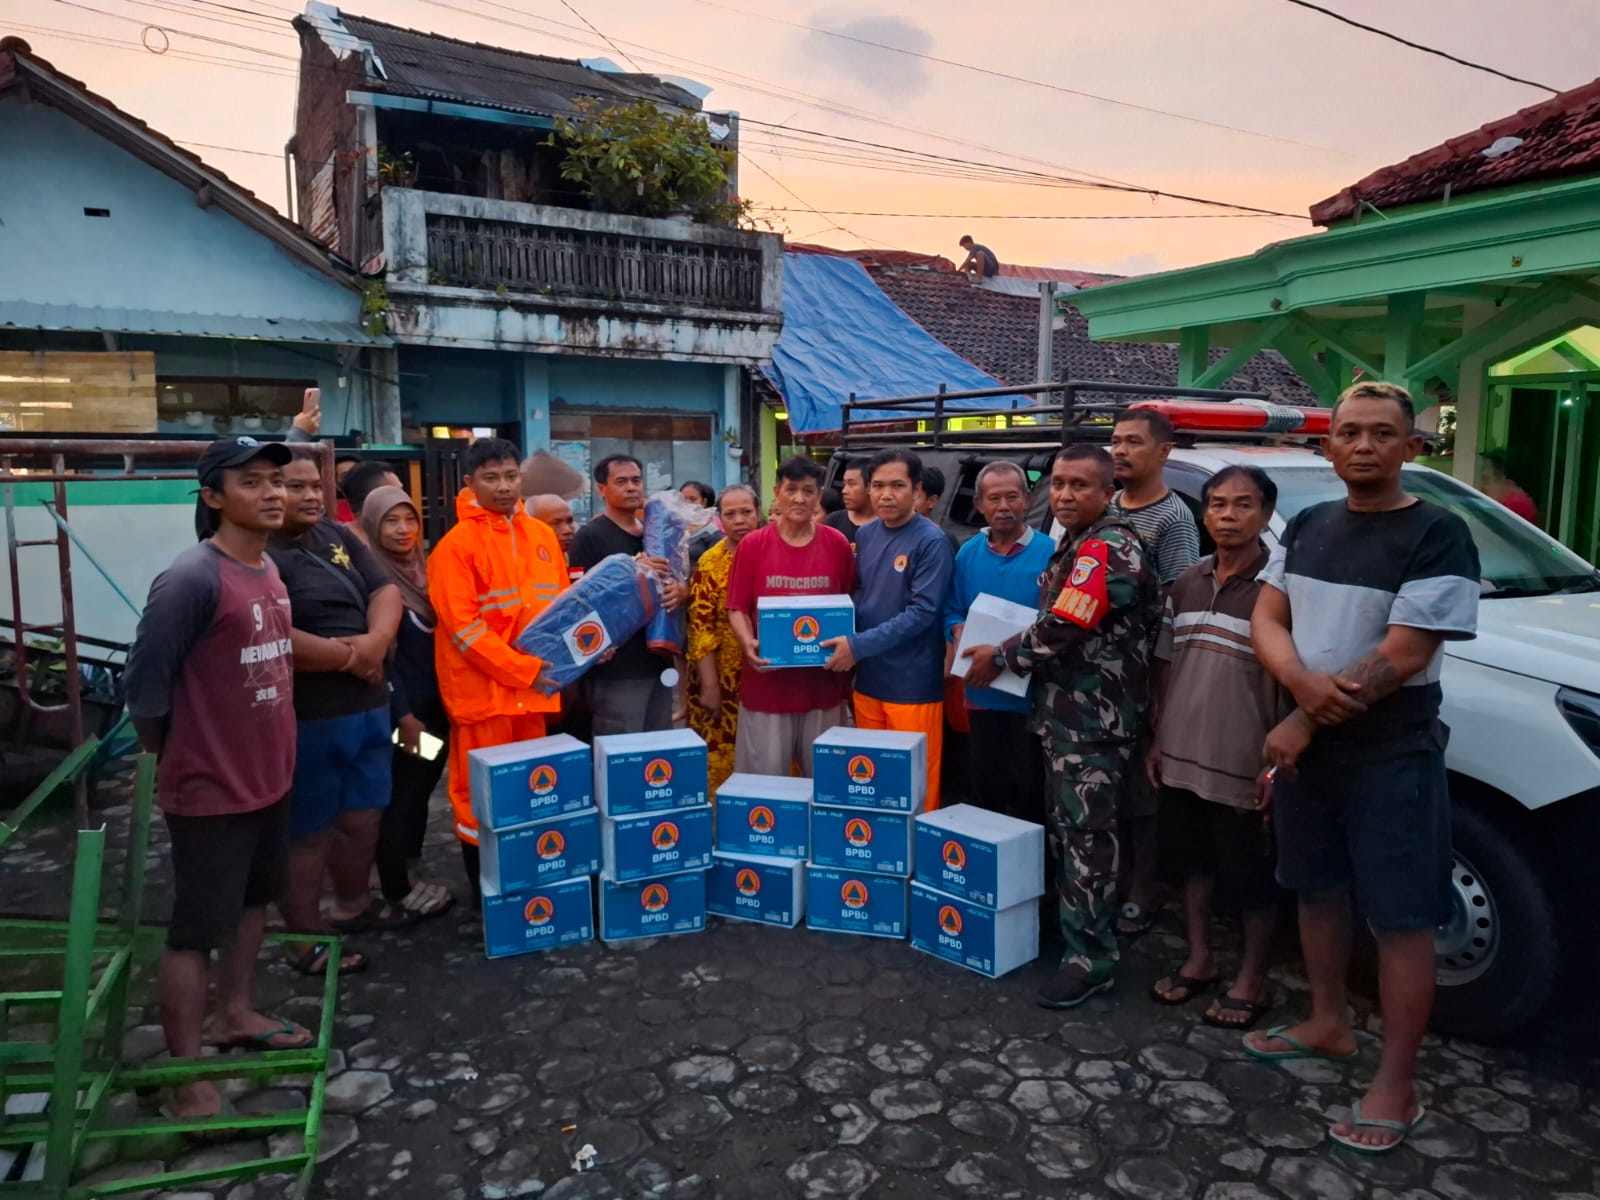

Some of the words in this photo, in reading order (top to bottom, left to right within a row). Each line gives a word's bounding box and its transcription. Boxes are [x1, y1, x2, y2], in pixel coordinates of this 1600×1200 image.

[766, 576, 830, 589] MOTOCROSS
[793, 645, 820, 653] BPBD
[645, 788, 672, 799] BPBD
[848, 785, 875, 795] BPBD
[530, 794, 558, 808] BPBD
[749, 834, 774, 844] BPBD
[652, 851, 679, 863] BPBD
[845, 848, 872, 858] BPBD
[538, 859, 566, 873] BPBD
[942, 870, 966, 885] BPBD
[736, 896, 760, 908] BPBD
[641, 912, 669, 924] BPBD
[841, 909, 868, 920] BPBD
[526, 925, 555, 938] BPBD
[938, 934, 963, 950] BPBD
